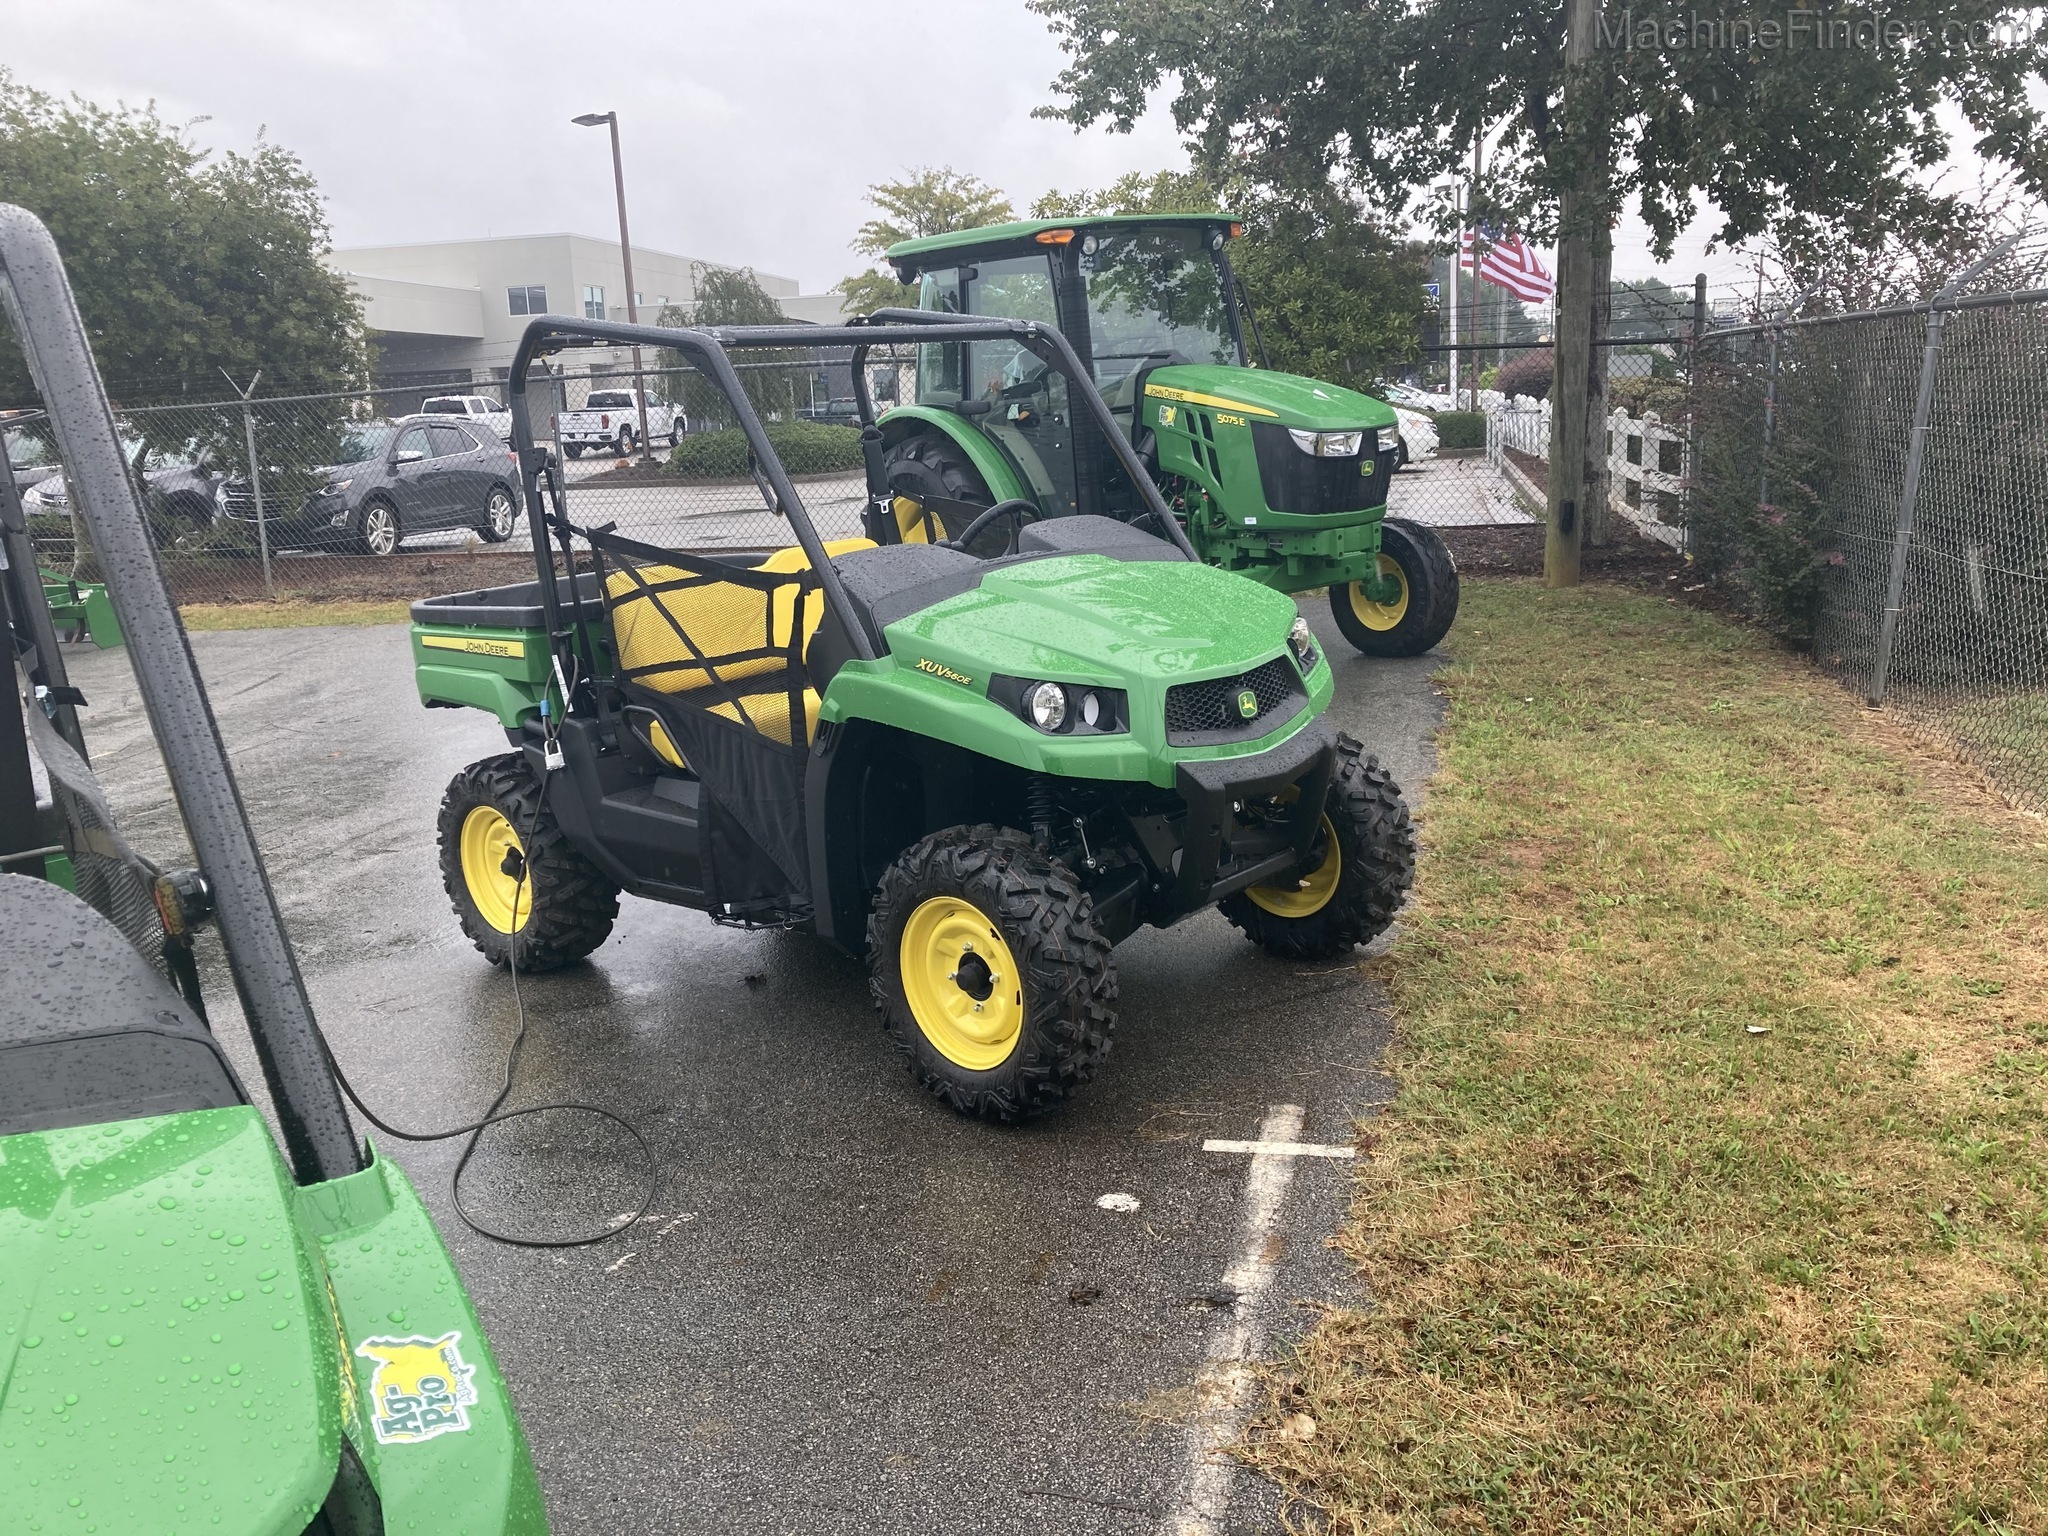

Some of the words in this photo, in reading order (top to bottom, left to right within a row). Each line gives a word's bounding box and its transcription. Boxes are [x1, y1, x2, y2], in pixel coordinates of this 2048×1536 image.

[1149, 386, 1164, 397] JOHN
[1164, 389, 1184, 400] DEERE
[464, 640, 484, 652] JOHN
[485, 642, 509, 656] DEERE
[443, 1347, 472, 1402] AgProCo.com
[380, 1386, 423, 1435] Ag-
[420, 1377, 461, 1430] Pro
